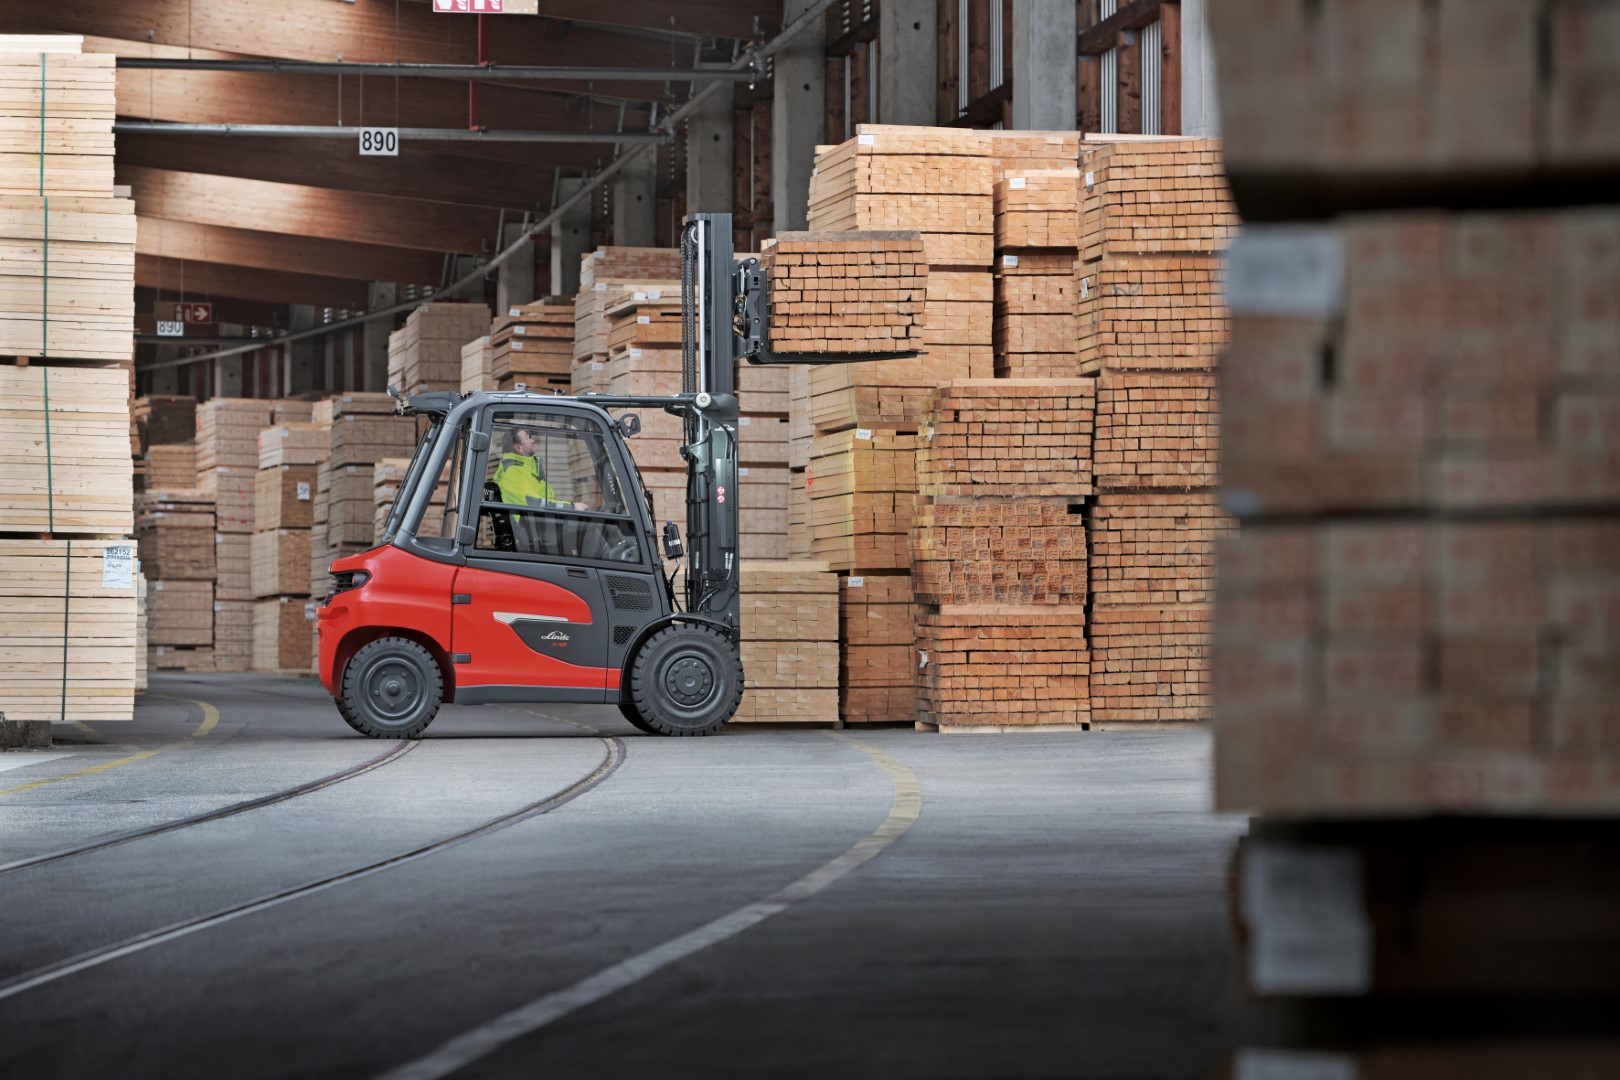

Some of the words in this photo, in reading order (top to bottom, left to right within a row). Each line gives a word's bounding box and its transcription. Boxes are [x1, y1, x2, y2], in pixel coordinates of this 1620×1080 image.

[362, 131, 396, 151] 890
[159, 321, 181, 333] 890
[541, 631, 570, 640] Linde
